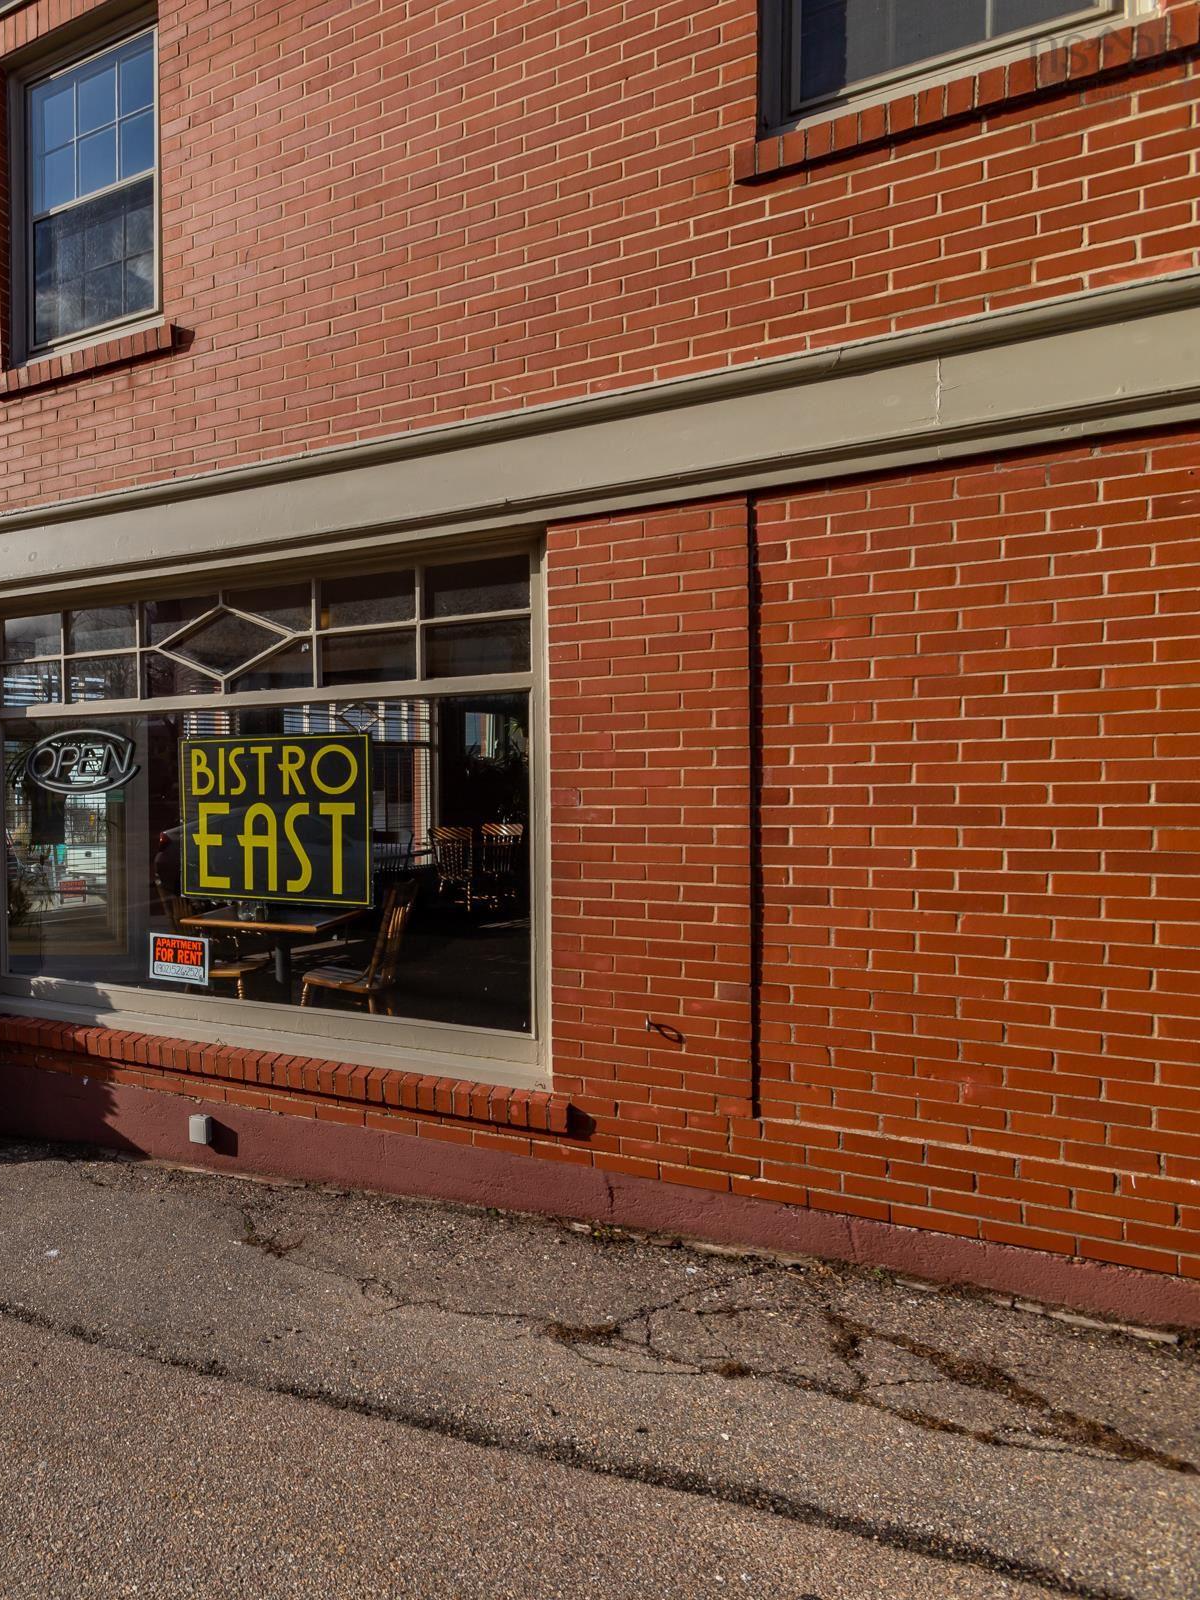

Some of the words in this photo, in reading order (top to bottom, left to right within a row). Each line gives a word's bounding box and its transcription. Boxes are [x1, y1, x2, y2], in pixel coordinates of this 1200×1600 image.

[31, 743, 132, 778] OPEN
[191, 743, 359, 796] BISTRO
[191, 802, 356, 895] EAST
[155, 947, 174, 962] FOR
[178, 950, 203, 965] RENT
[156, 938, 202, 950] APARTMENT
